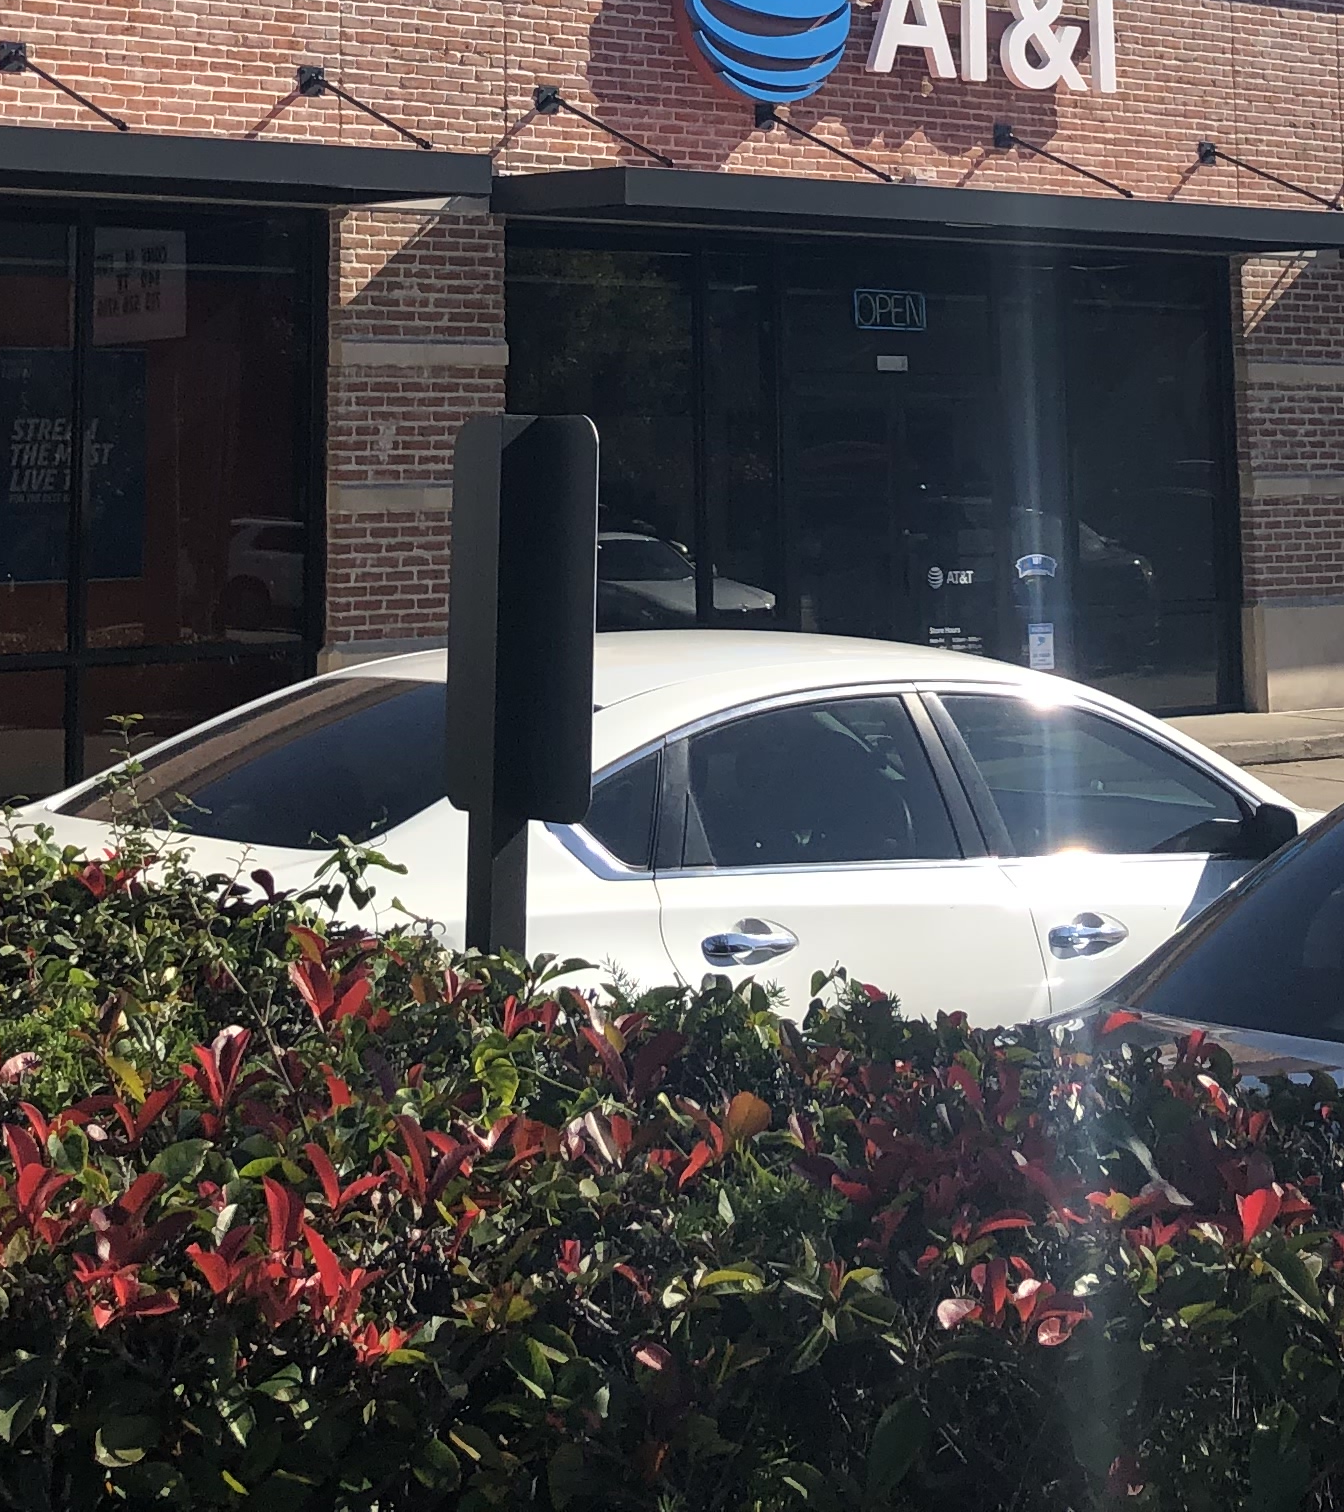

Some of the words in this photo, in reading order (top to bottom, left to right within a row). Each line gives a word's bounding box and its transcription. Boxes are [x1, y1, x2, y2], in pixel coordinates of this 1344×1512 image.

[858, 293, 923, 327] OPEN
[11, 442, 50, 467] THE
[53, 443, 115, 467] MST
[9, 468, 58, 492] LIVE
[946, 570, 975, 585] AT&T
